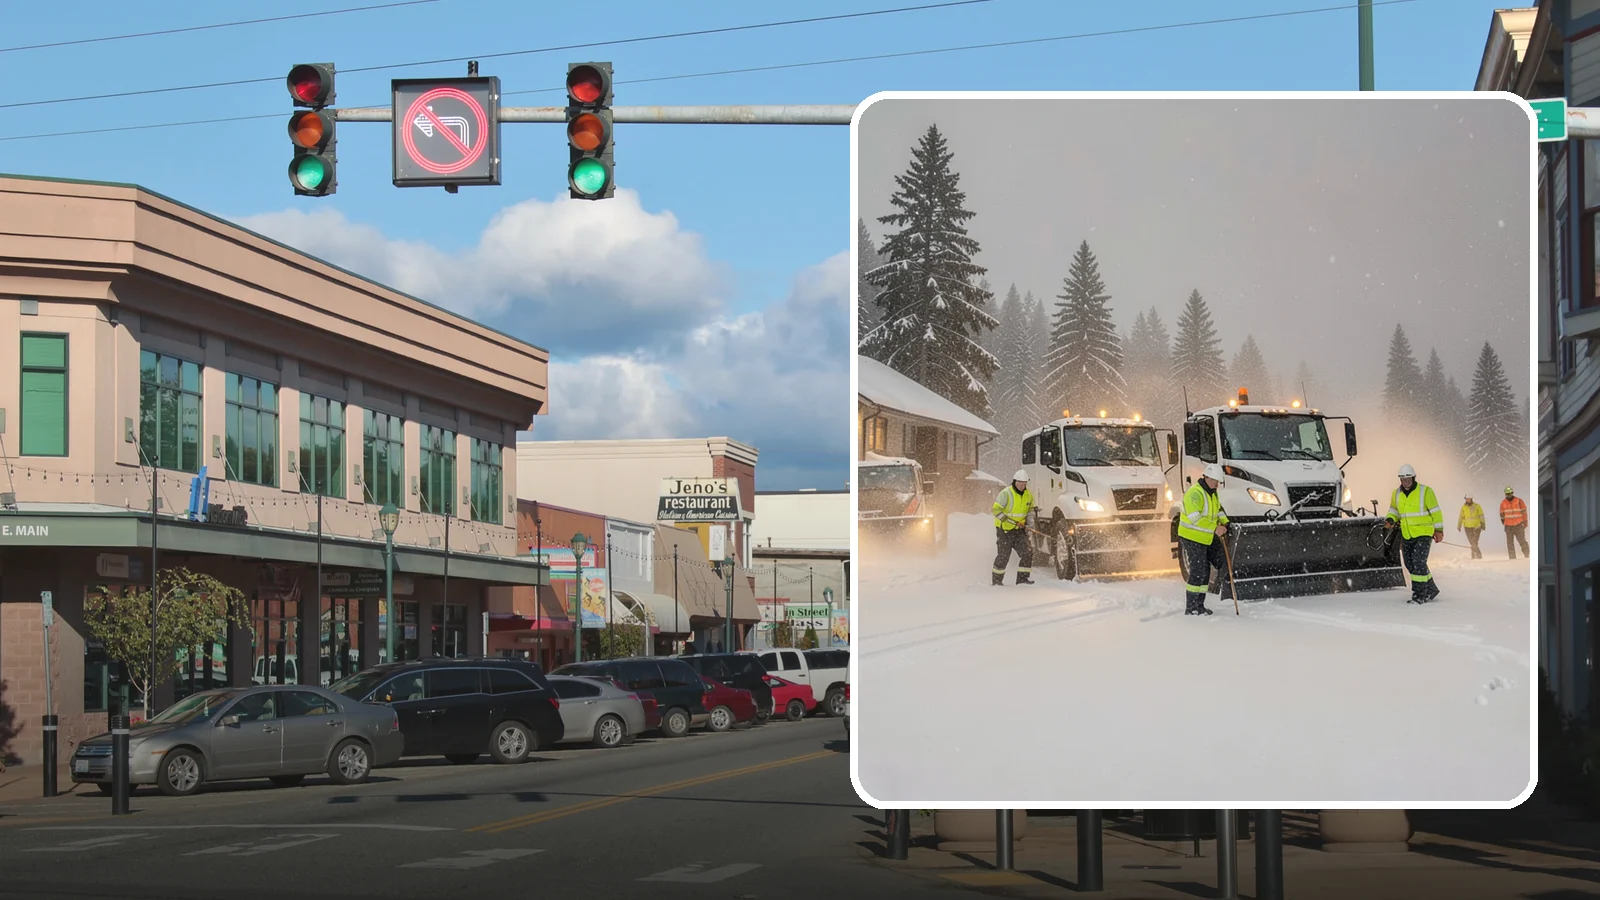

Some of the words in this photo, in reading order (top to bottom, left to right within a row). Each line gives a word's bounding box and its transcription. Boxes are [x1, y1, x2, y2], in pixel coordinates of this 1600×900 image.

[670, 480, 727, 494] Jeno's
[665, 497, 731, 509] restaurant
[659, 510, 681, 519] Italian
[686, 510, 714, 519] American
[715, 510, 737, 519] Cuisine
[2, 525, 13, 536] E.
[15, 525, 49, 536] MAIN
[797, 607, 828, 616] Street
